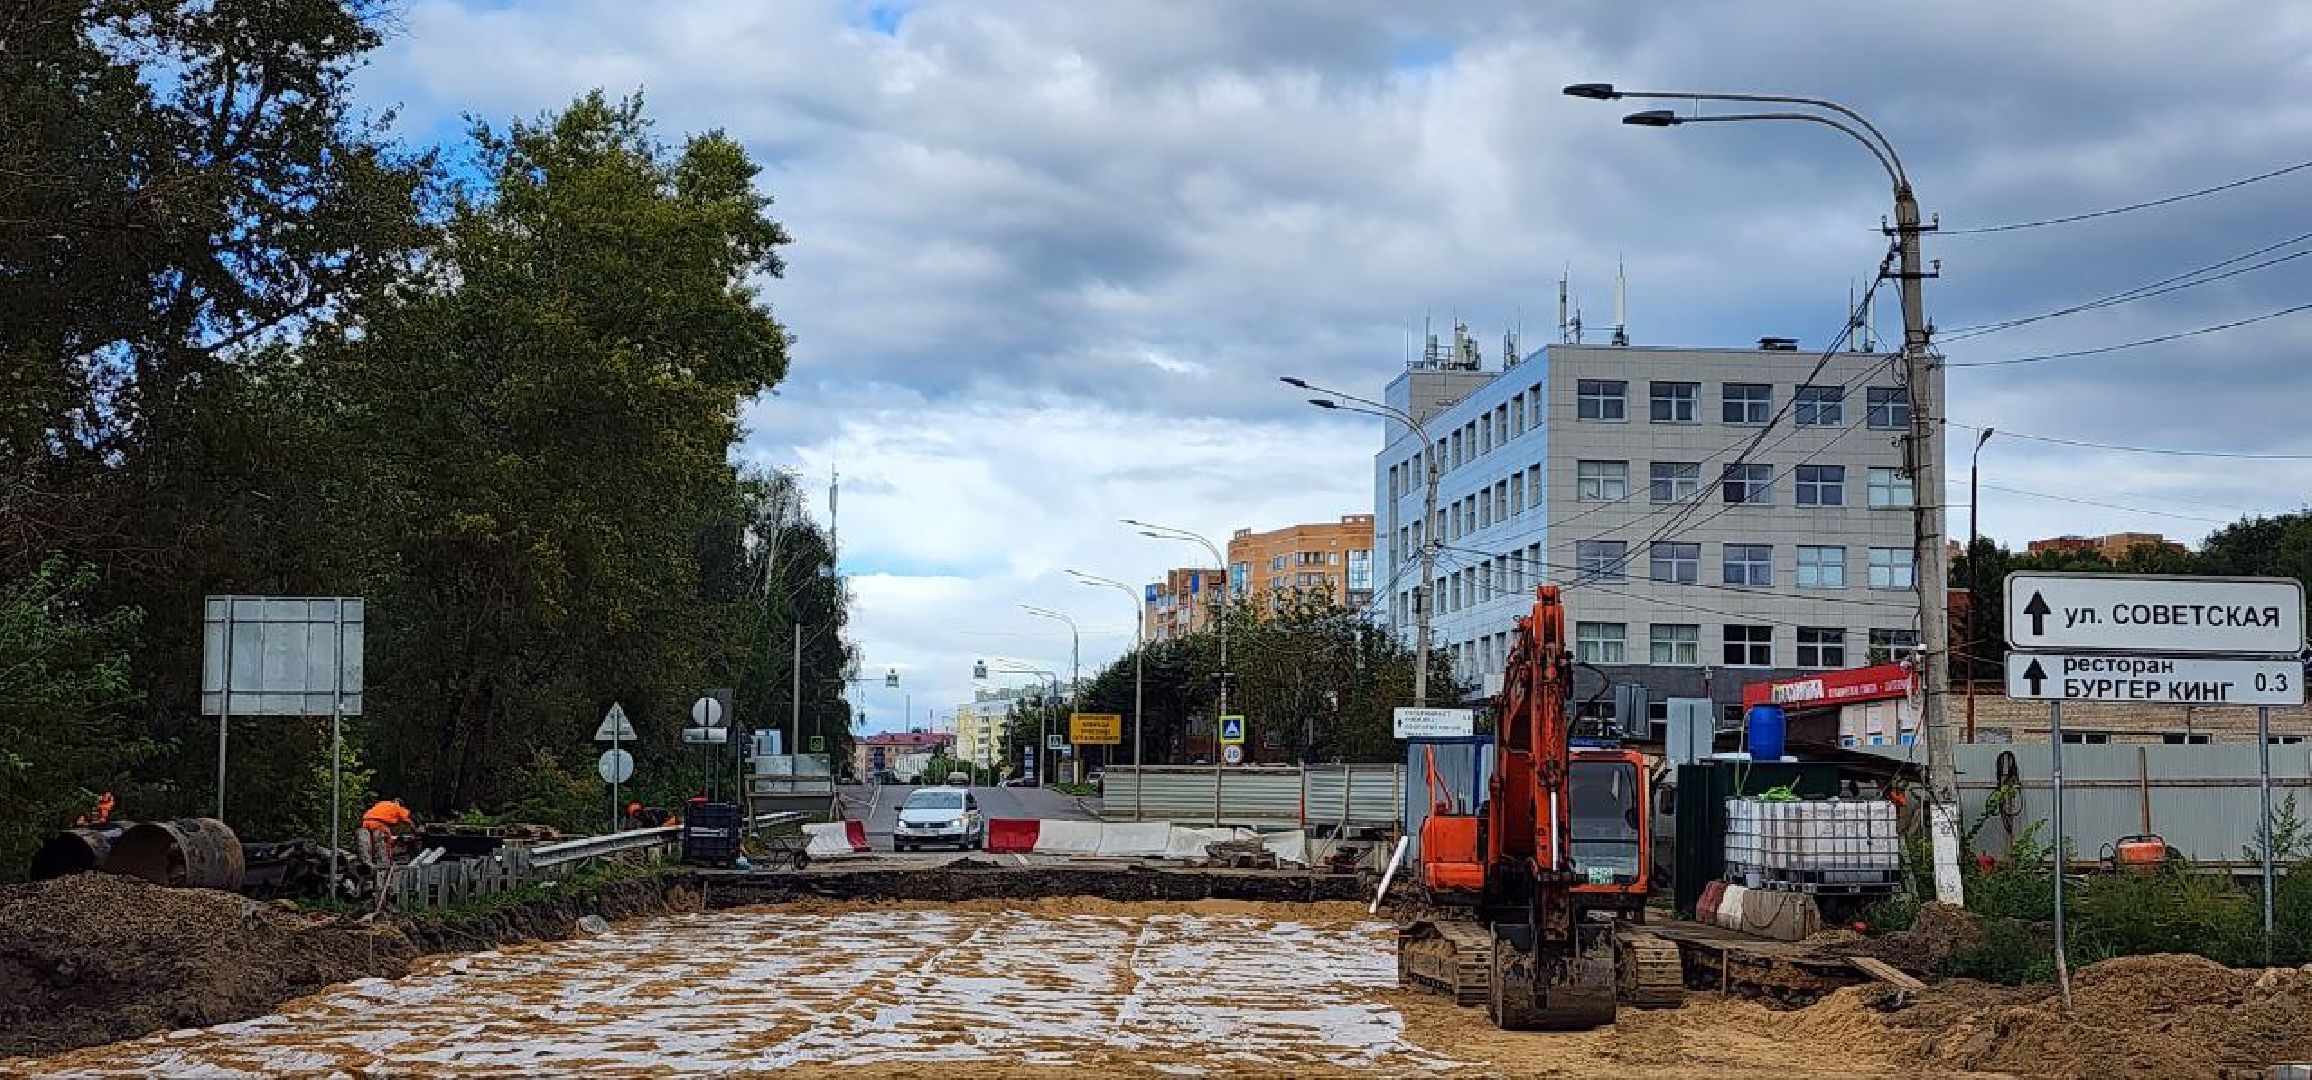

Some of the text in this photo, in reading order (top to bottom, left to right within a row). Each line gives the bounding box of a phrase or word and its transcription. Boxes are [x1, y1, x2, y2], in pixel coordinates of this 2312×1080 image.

[2064, 602, 2281, 629] ул. СОВЕТСКАЯ
[2063, 657, 2175, 677] ресторан
[2064, 678, 2235, 701] БУРГЕР КИНГ
[2254, 672, 2289, 693] 0.3
